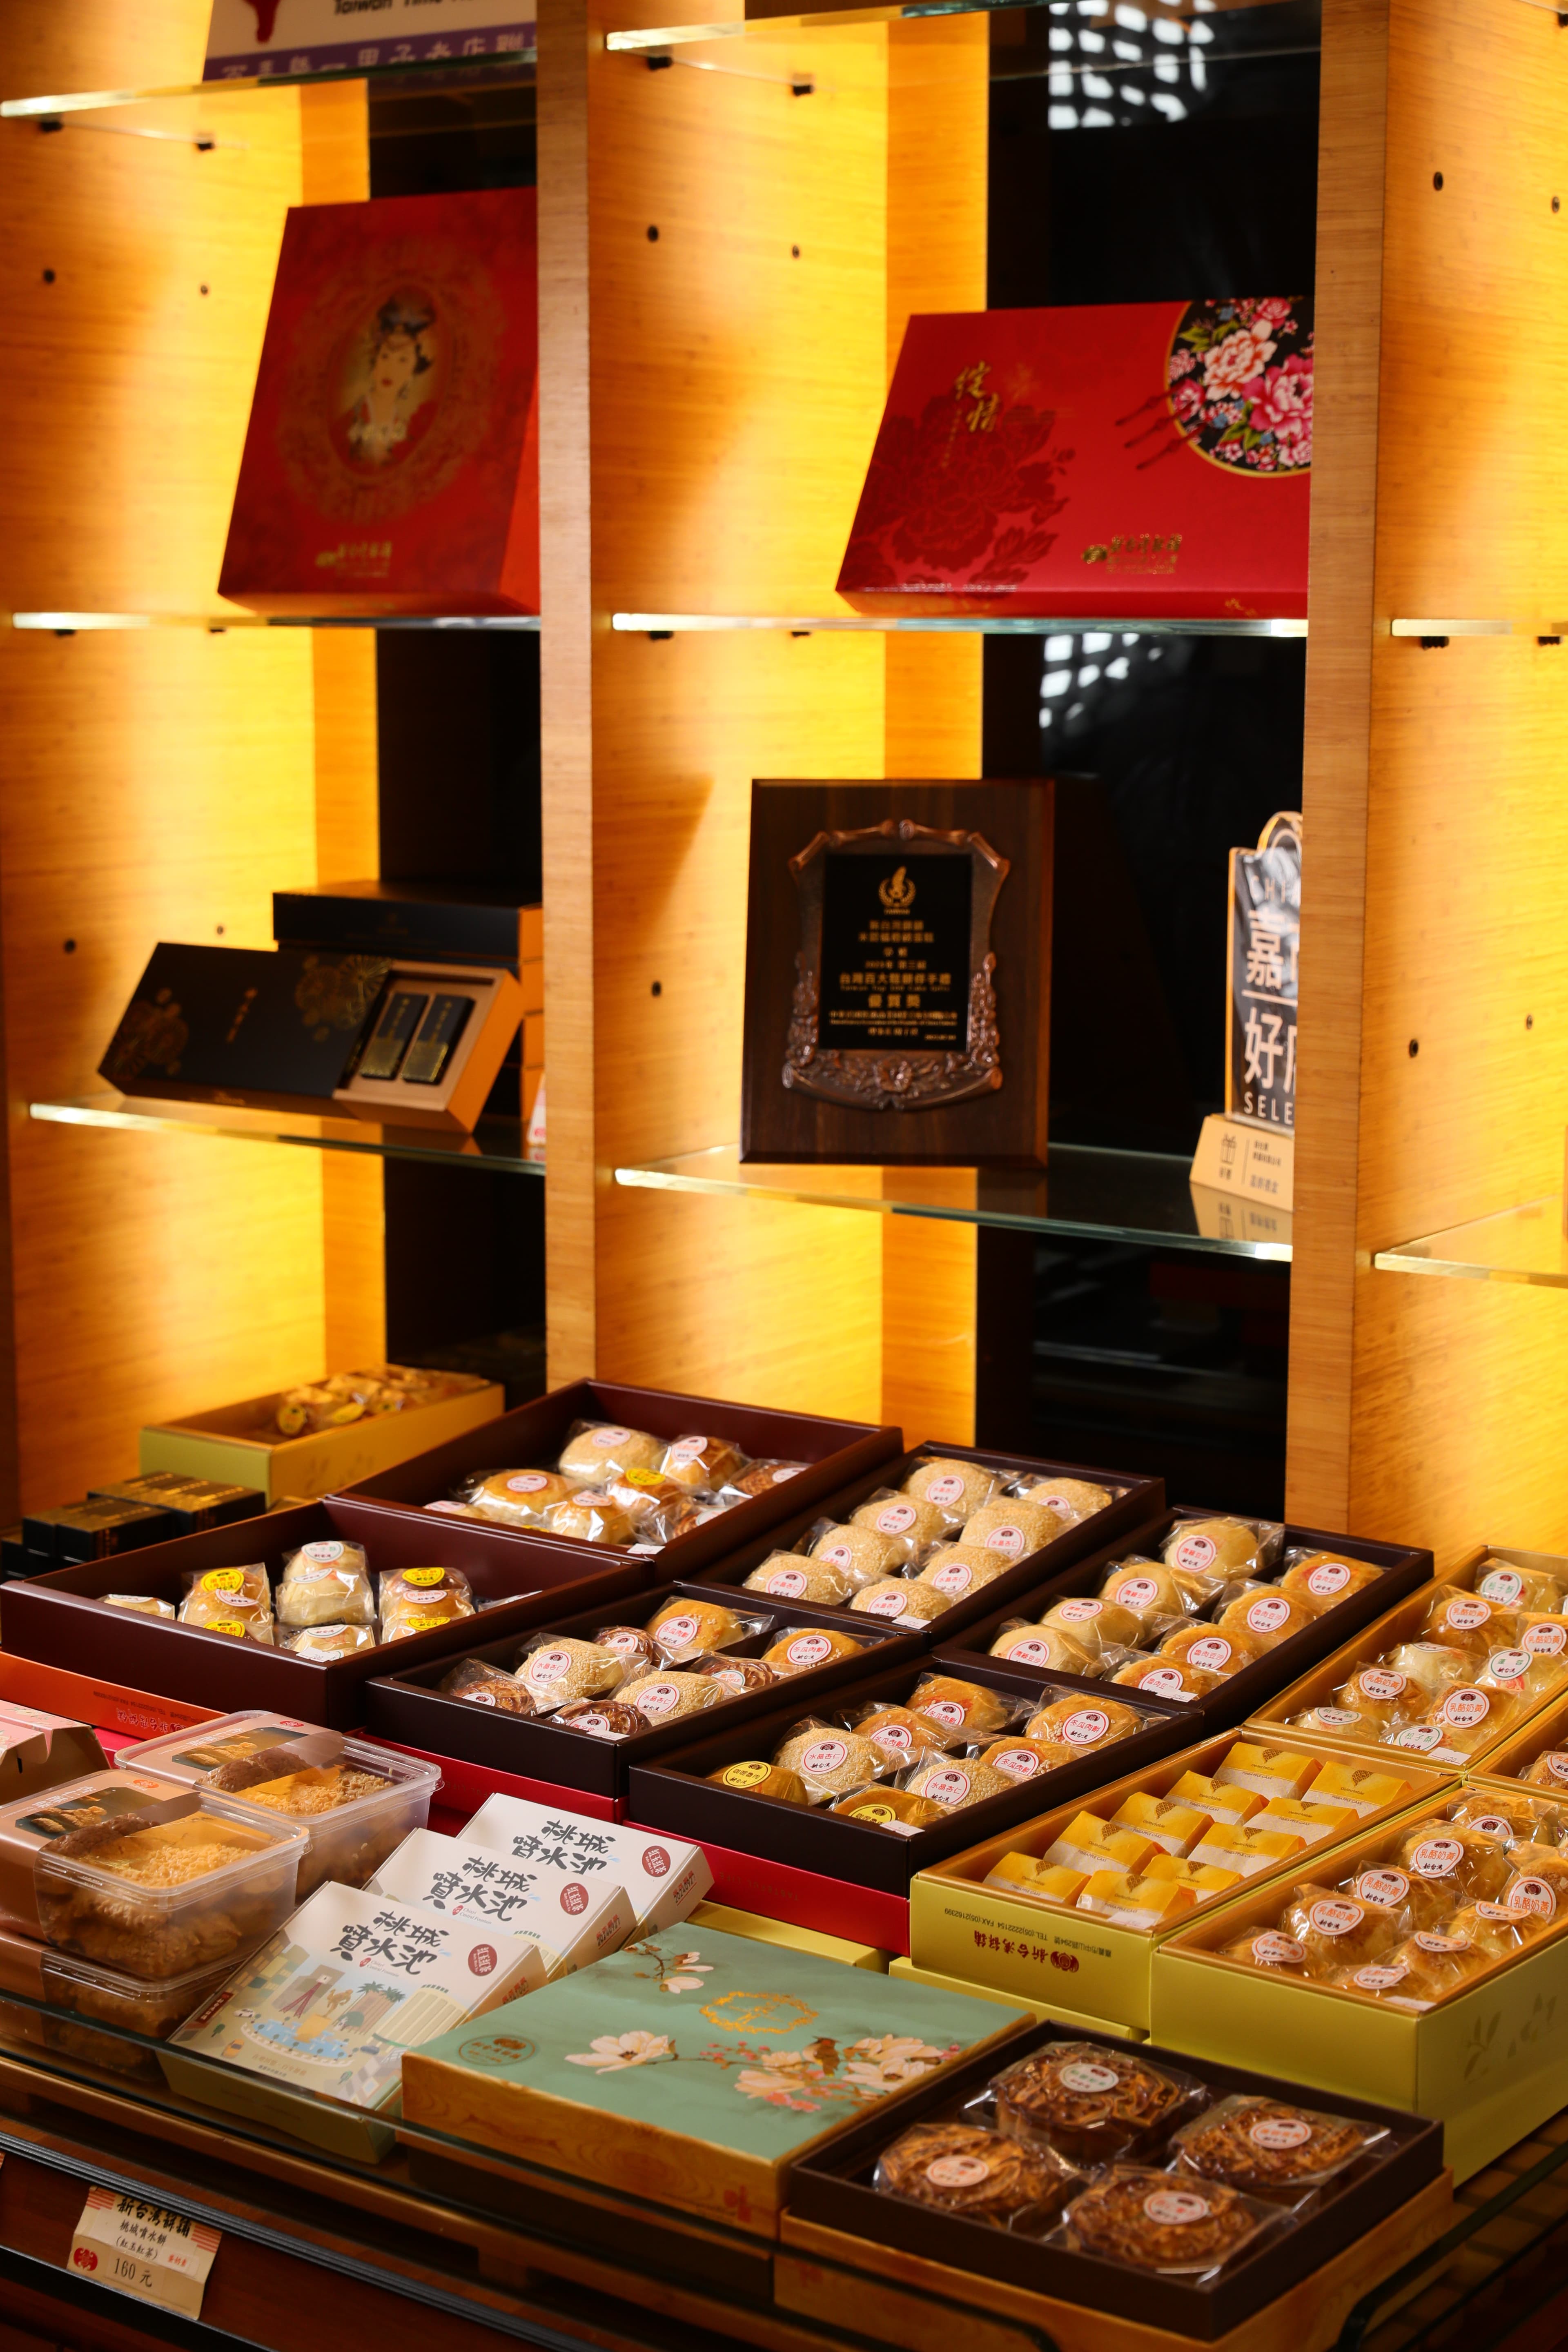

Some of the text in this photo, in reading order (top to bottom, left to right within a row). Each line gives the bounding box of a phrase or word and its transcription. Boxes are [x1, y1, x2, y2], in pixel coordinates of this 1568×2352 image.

[1244, 1091, 1293, 1125] SELE
[537, 1662, 564, 1672] 水晶杏仁
[1365, 1674, 1400, 1689] 乳酪奶黃
[643, 1694, 671, 1706] 水晶杏仁
[1449, 1702, 1484, 1713] 乳酪奶黃
[1070, 1719, 1101, 1733] 冬瓜肉餅
[1405, 1731, 1433, 1744] 松子酥
[1251, 1763, 1275, 1771] Delectable
[930, 1782, 962, 1796] 水晶杏仁
[1340, 1786, 1365, 1795] Delectable
[1198, 1793, 1222, 1802] Delectable
[1189, 1802, 1208, 1810] PINEAPPLE
[1142, 1819, 1166, 1829] Delectable
[541, 1819, 616, 1854] 桃城
[1132, 1828, 1150, 1836] PINEAPPLE
[1088, 1840, 1111, 1852] Delectable
[1232, 1841, 1258, 1849] Delectable
[1420, 1848, 1457, 1862] 乳酪奶黃
[462, 1856, 538, 1893] 桃城
[1366, 1877, 1400, 1898] 乳酪奶黃
[422, 1871, 527, 1922] 噴水池
[1514, 1896, 1550, 1915] 乳酪奶黃
[1318, 1906, 1355, 1924] 乳酪奶黃
[373, 1910, 450, 1948] 桃城
[330, 1924, 437, 1976] 噴水池
[119, 2219, 168, 2246] 桃城噴水餅
[113, 2257, 153, 2288] 160 元
